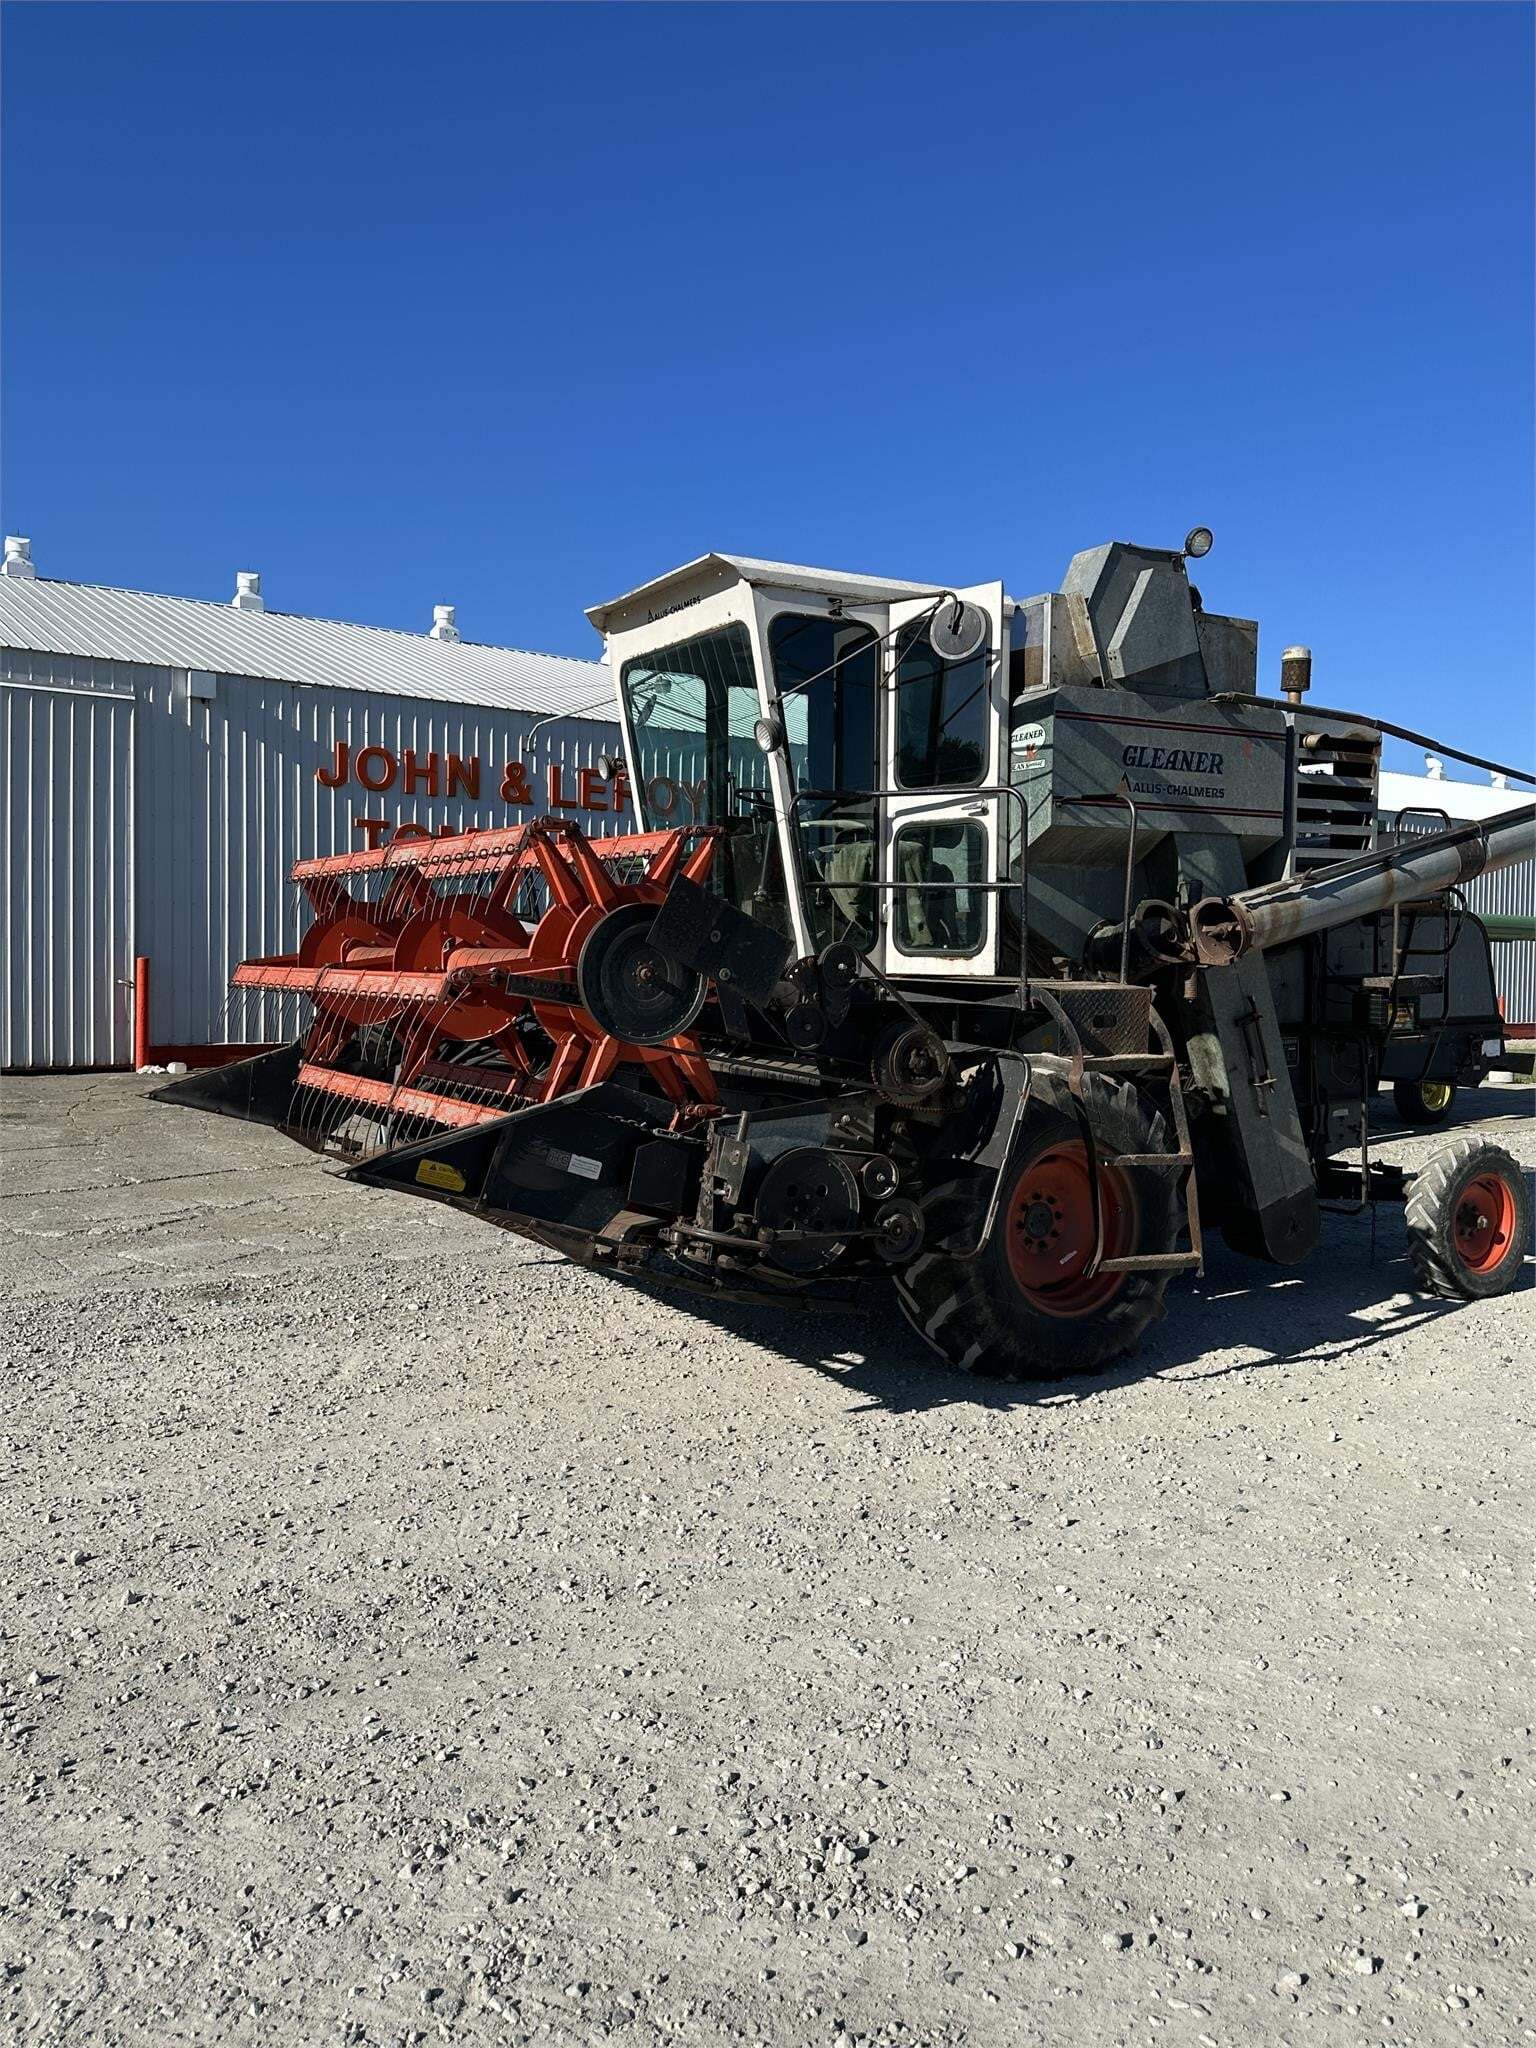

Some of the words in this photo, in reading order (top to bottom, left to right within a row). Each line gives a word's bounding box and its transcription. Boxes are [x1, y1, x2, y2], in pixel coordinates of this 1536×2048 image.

[316, 741, 481, 800] JOHN
[499, 760, 534, 805] &
[1122, 745, 1224, 775] GLEANER
[1133, 782, 1225, 799] ALLIS-CHALMERS
